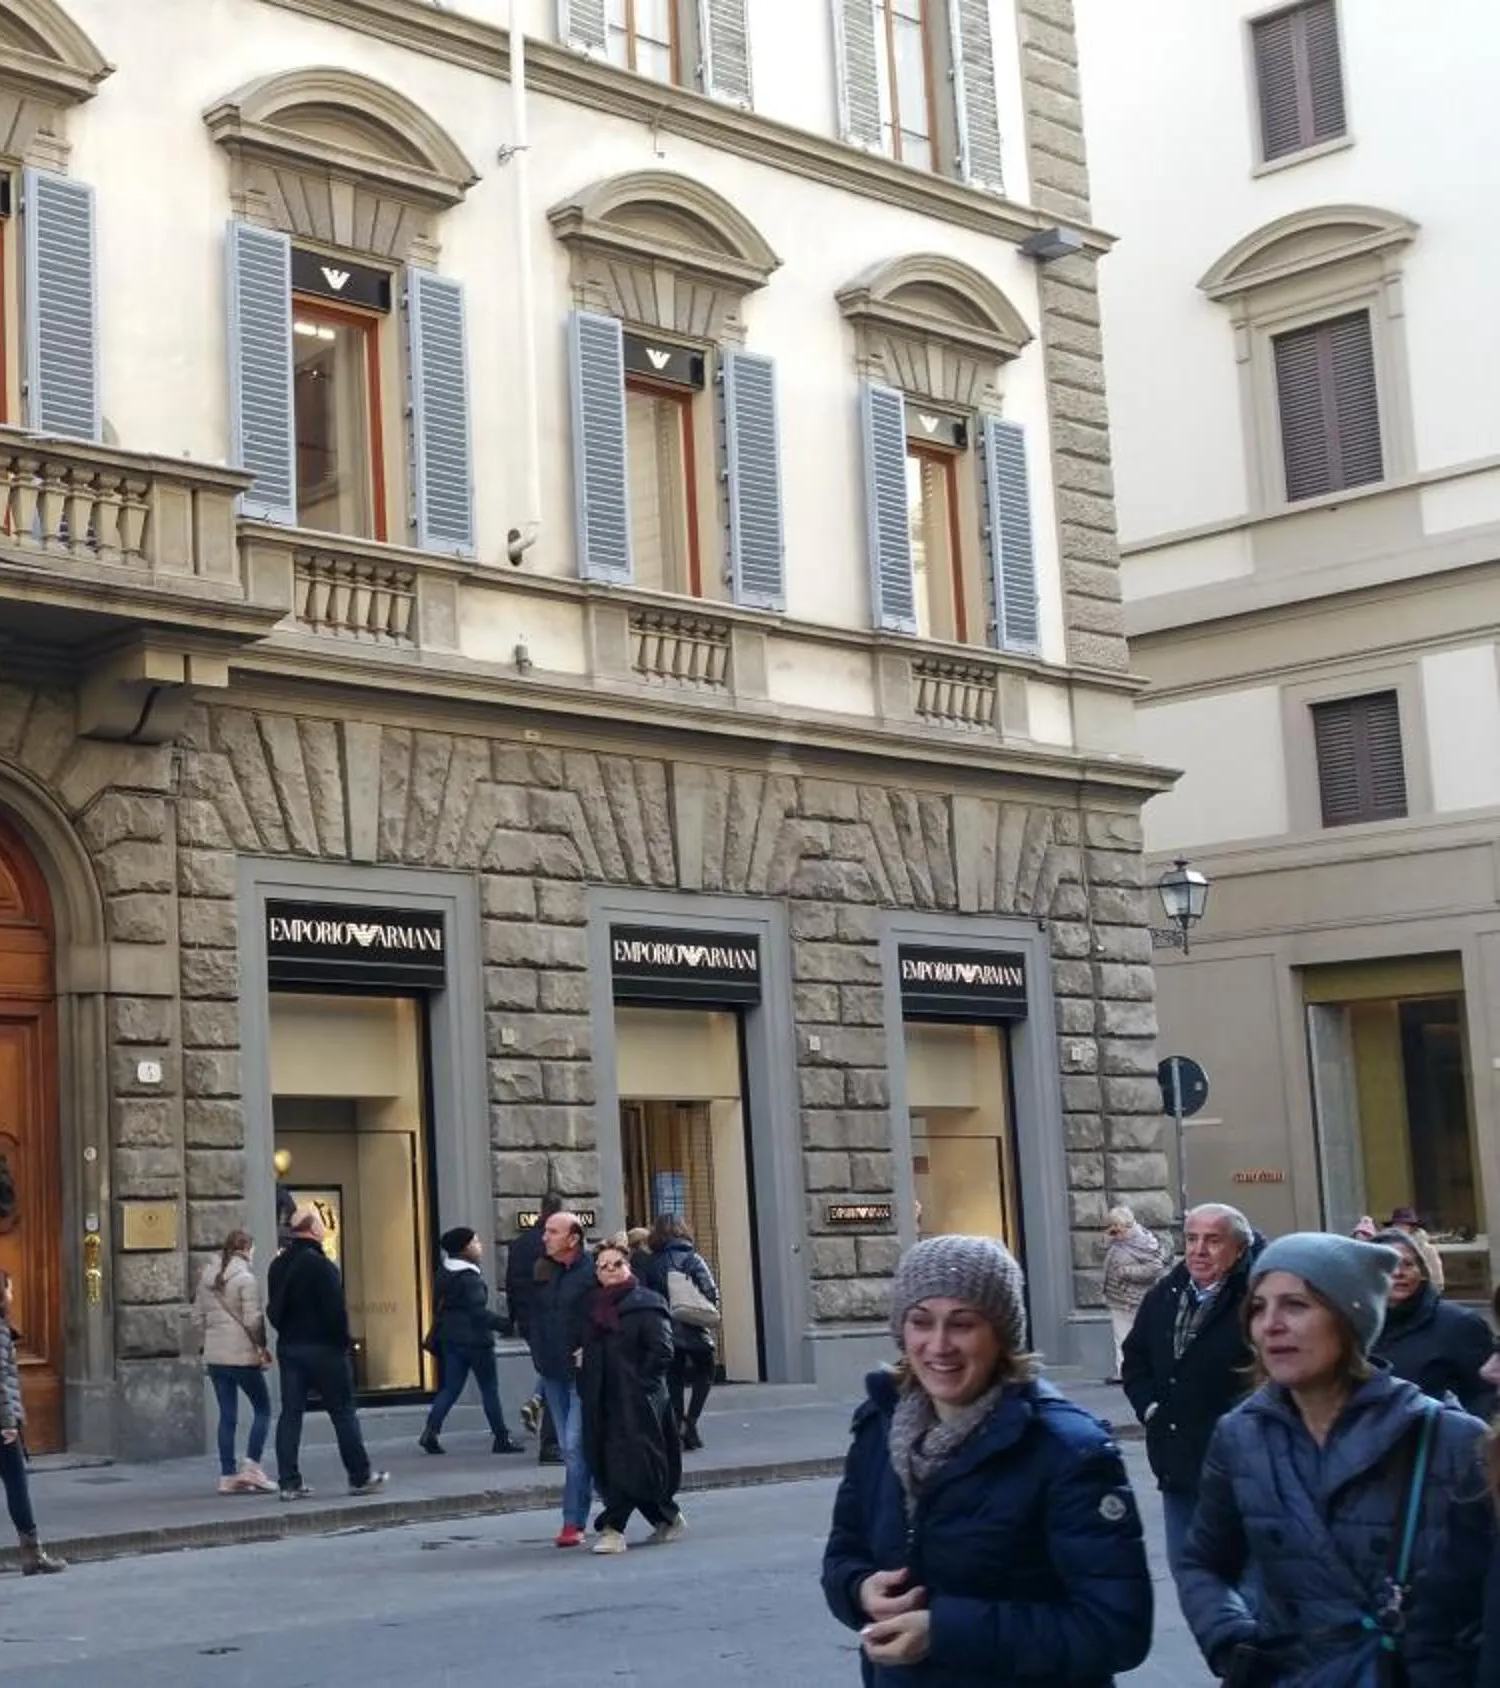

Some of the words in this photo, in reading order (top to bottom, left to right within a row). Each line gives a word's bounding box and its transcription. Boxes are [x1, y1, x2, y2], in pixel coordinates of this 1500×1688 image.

[270, 918, 350, 945] EMPORIO
[375, 925, 441, 950] ARMANI
[613, 939, 682, 966] EMPORIO
[701, 947, 757, 971] ARMANI
[902, 960, 958, 983] EMPORIO
[975, 965, 1023, 987] ARMANI
